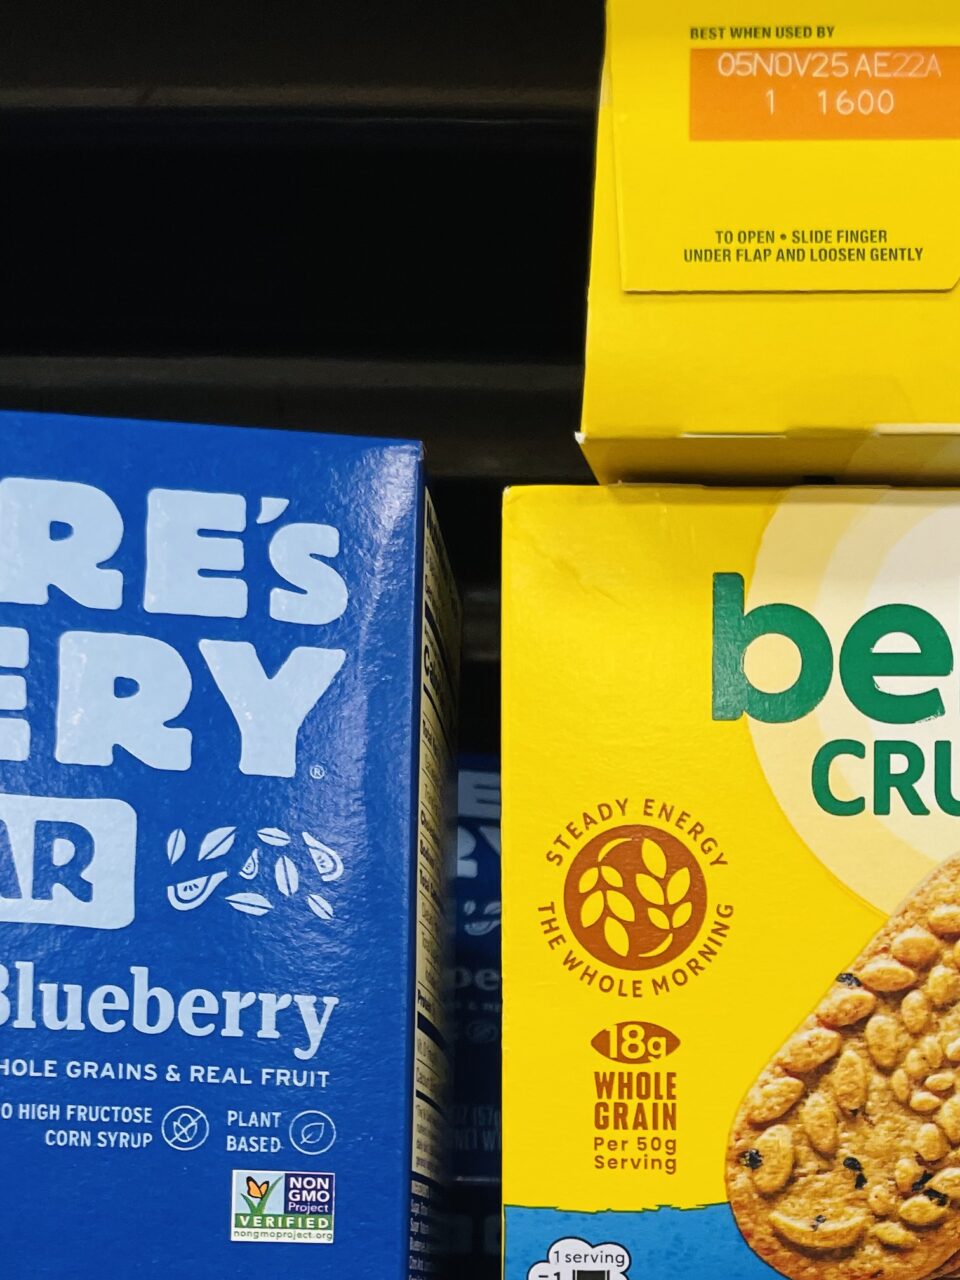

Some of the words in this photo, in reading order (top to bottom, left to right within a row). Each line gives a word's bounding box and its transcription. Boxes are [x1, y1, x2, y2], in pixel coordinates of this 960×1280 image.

[690, 26, 725, 40] BEST
[729, 26, 772, 40] WHEN
[775, 26, 812, 39] USED
[816, 25, 835, 39] BY
[715, 230, 733, 245] TO
[737, 230, 775, 245] OPEN
[792, 229, 831, 244] SLIDE
[836, 229, 888, 244] FINGER
[546, 798, 629, 868] STEADY
[644, 798, 729, 869] ENERGY
[0, 961, 339, 1060] lueberry
[606, 1024, 667, 1063] 18g
[66, 1060, 158, 1082] GRAINS
[190, 1066, 253, 1086] REAL
[261, 1068, 331, 1088] FRUIT
[594, 1071, 677, 1101] WHOLE
[19, 1103, 60, 1121] HIGH
[66, 1105, 153, 1124] FRUCTOSE
[227, 1110, 282, 1130] PLANT
[594, 1102, 677, 1132] GRAIN
[45, 1130, 92, 1147] CORN
[97, 1131, 153, 1149] SYRUP
[226, 1136, 282, 1154] BASED
[594, 1136, 630, 1151] Per
[636, 1136, 677, 1155] 50g
[594, 1154, 677, 1175] Serving
[289, 1176, 330, 1191] NON
[288, 1189, 330, 1204] GMO
[288, 1201, 329, 1215] Project
[239, 1215, 330, 1230] VERIFIED
[233, 1229, 333, 1243] nongmoproject.org
